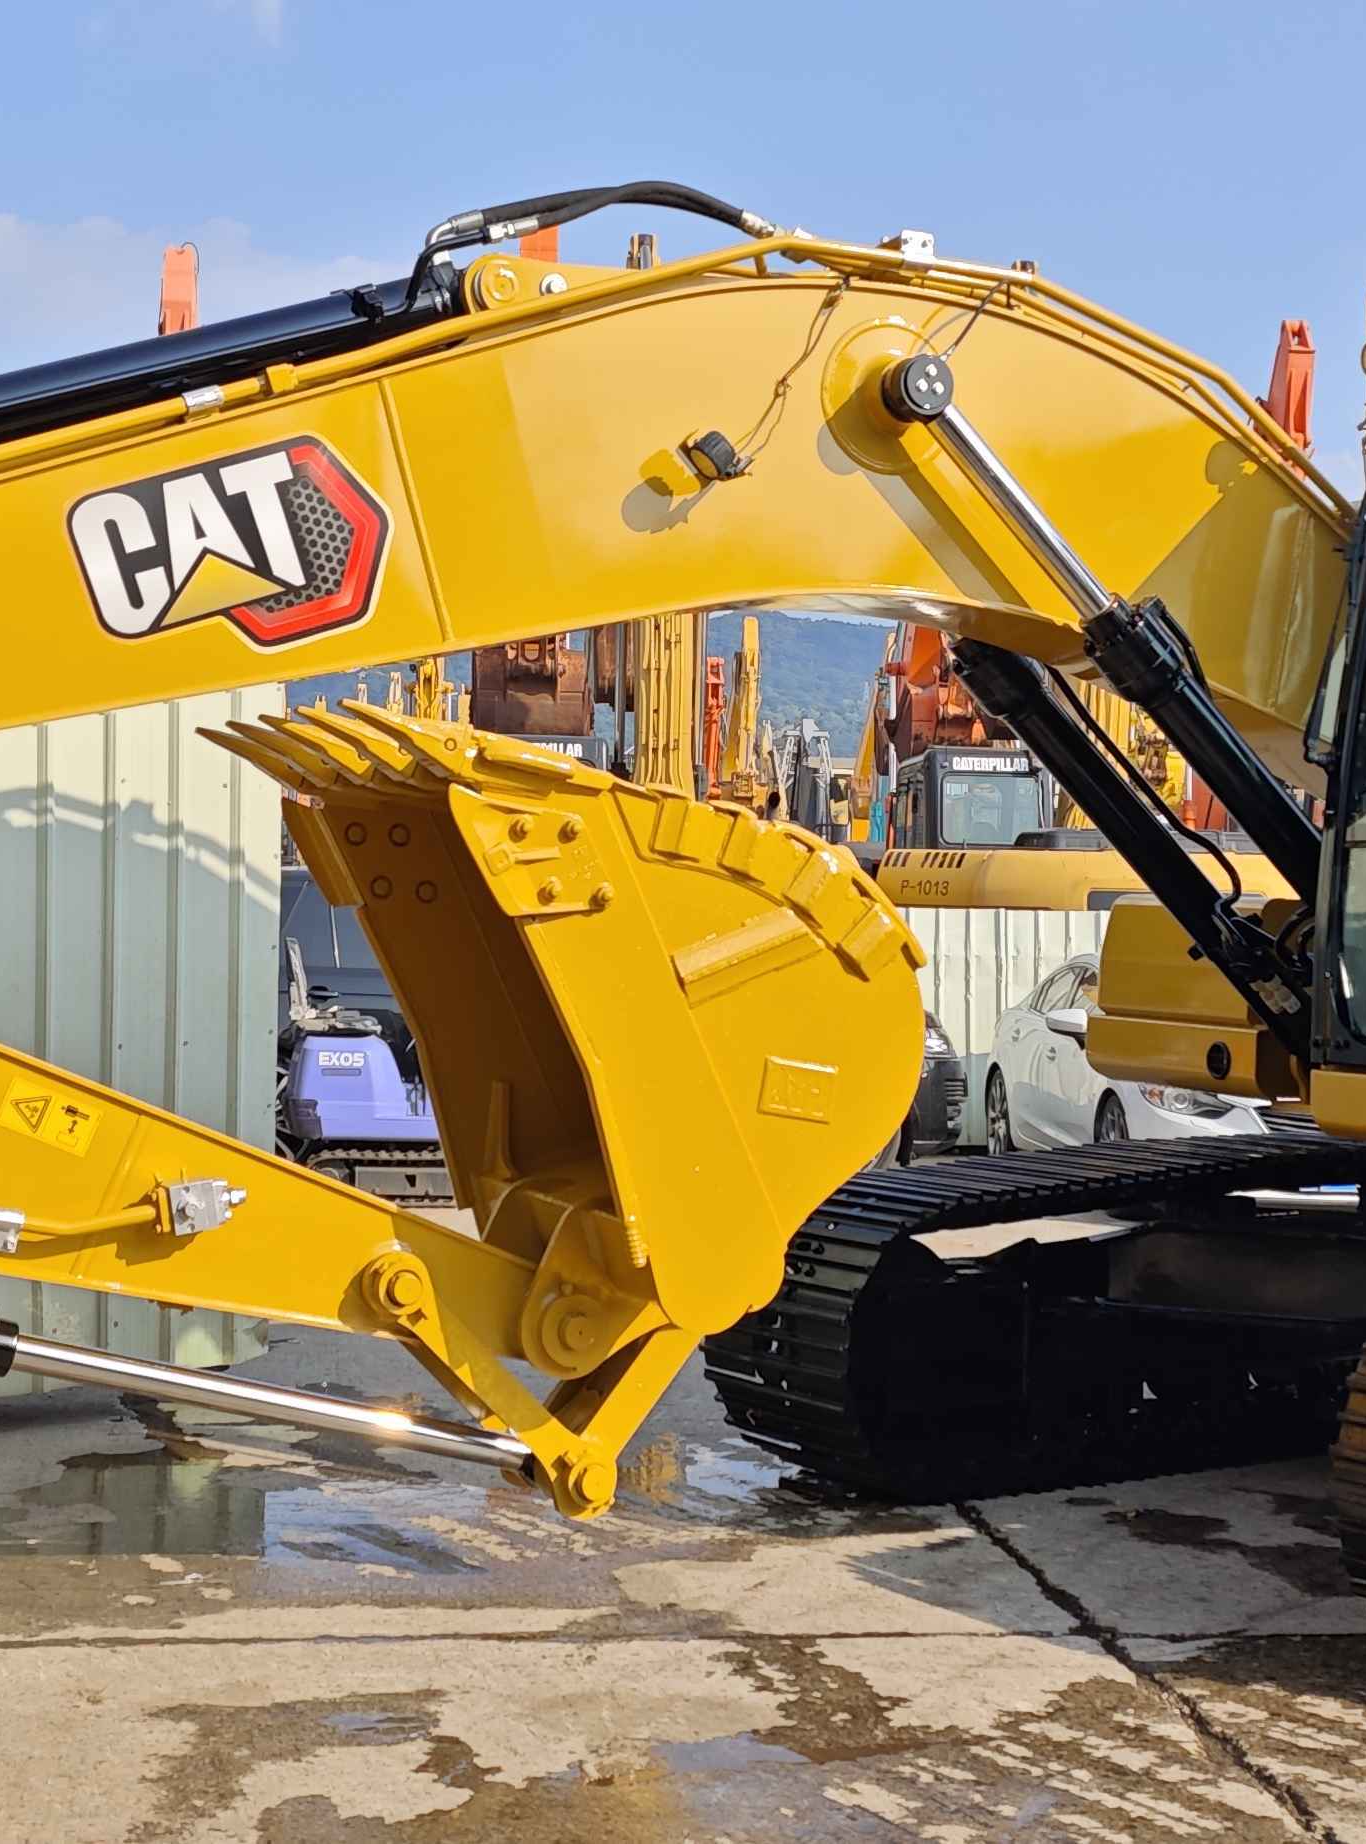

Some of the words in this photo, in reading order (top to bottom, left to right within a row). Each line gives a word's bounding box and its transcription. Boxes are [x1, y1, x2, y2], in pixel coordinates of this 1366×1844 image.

[71, 450, 306, 635] CAT
[952, 756, 1029, 772] CATERPILLAR
[900, 879, 949, 897] P-1013
